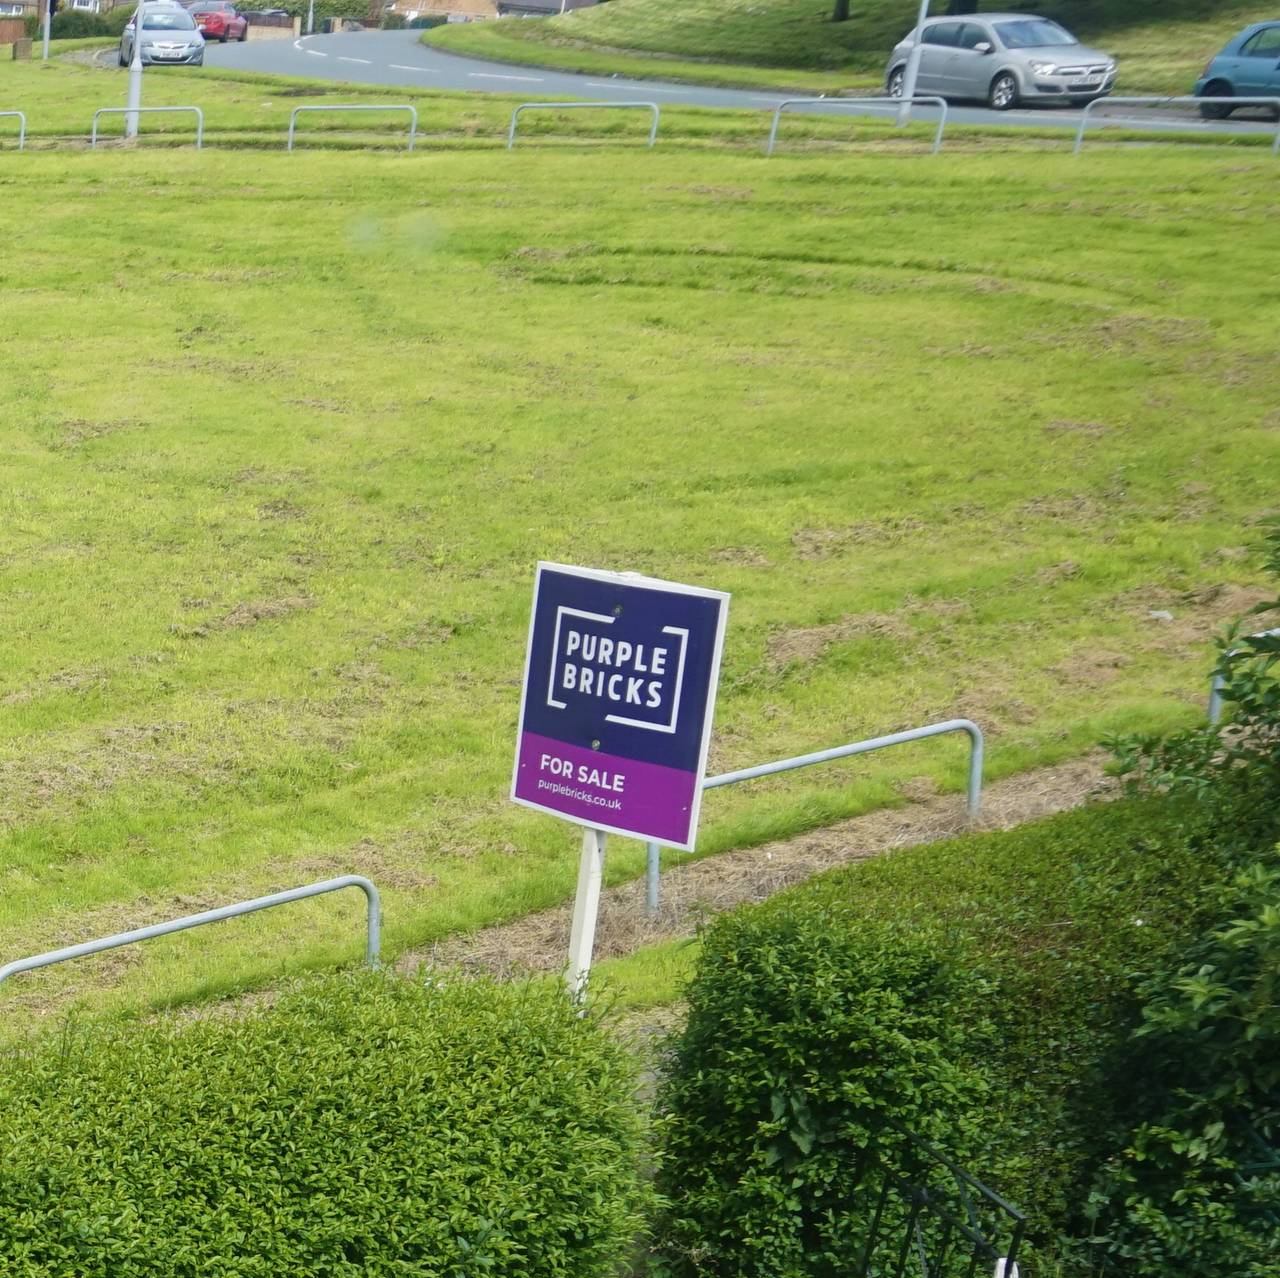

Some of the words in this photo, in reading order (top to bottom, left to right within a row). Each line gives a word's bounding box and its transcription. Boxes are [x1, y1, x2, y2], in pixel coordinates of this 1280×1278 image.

[566, 630, 668, 675] PURPLE
[563, 662, 663, 708] BRICKS
[540, 753, 573, 779] FOR
[577, 765, 626, 793] SALE
[538, 779, 622, 810] purplebricks.co.uk
